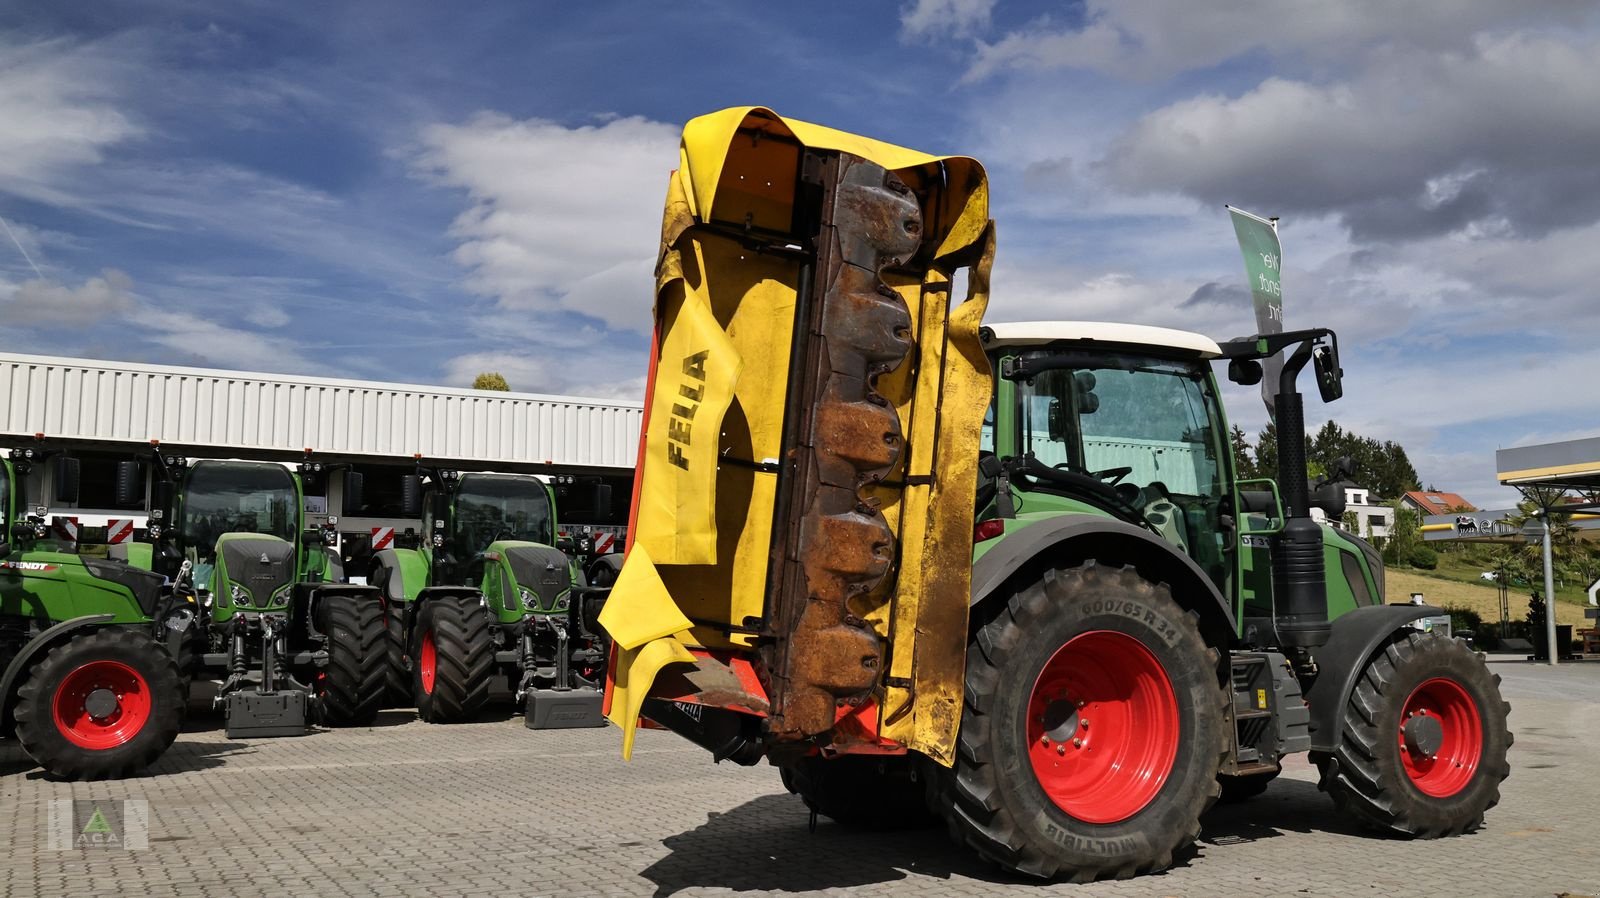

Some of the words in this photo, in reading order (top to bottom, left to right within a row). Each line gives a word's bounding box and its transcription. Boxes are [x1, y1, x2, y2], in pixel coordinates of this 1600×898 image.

[667, 349, 710, 472] FELLA
[8, 561, 48, 570] FENDT
[1081, 600, 1142, 617] 600/65
[1143, 608, 1157, 626] R
[1157, 621, 1177, 641] 34
[1044, 823, 1137, 855] MULTIBIB
